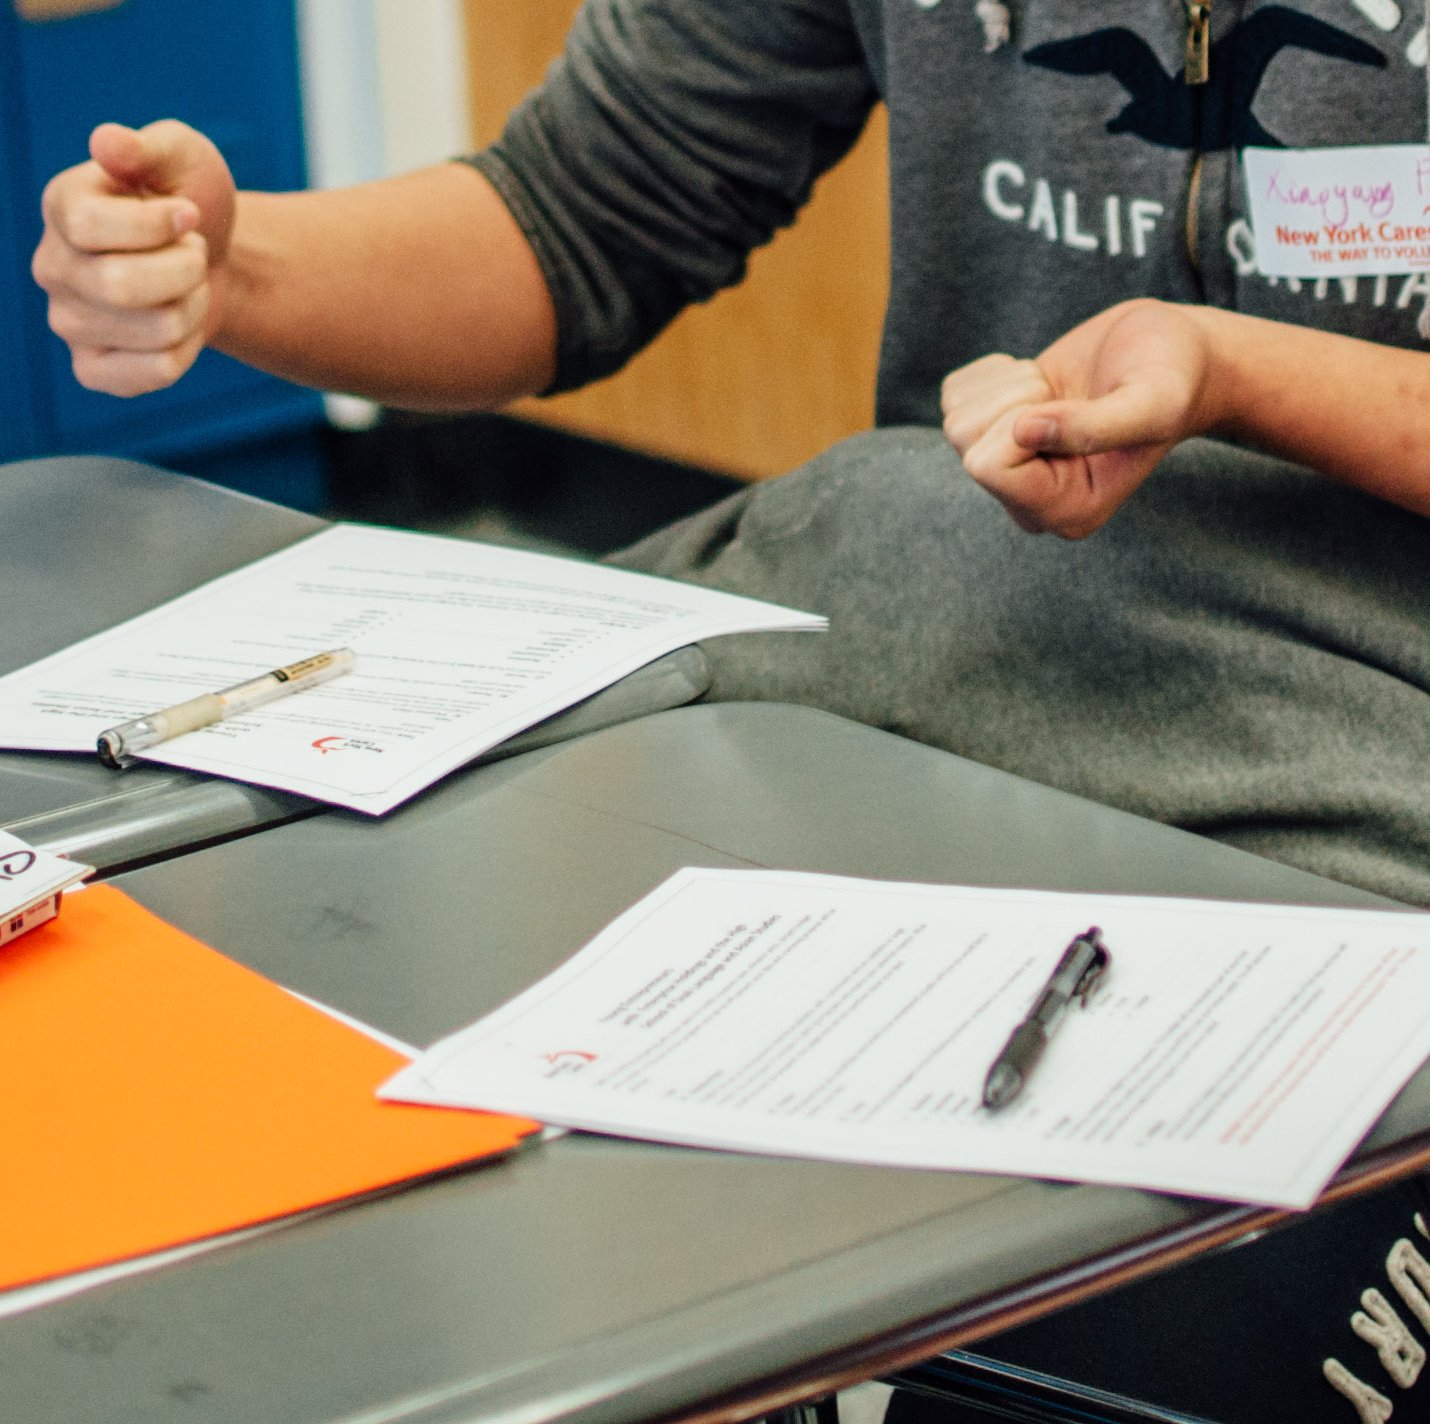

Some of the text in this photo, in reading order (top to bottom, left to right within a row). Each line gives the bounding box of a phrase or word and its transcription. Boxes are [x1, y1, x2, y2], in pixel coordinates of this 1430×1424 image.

[1276, 226, 1318, 245] New
[1324, 224, 1372, 244] York
[1310, 250, 1333, 261] THE
[1338, 247, 1368, 261] WAY
[1374, 247, 1391, 258] TO
